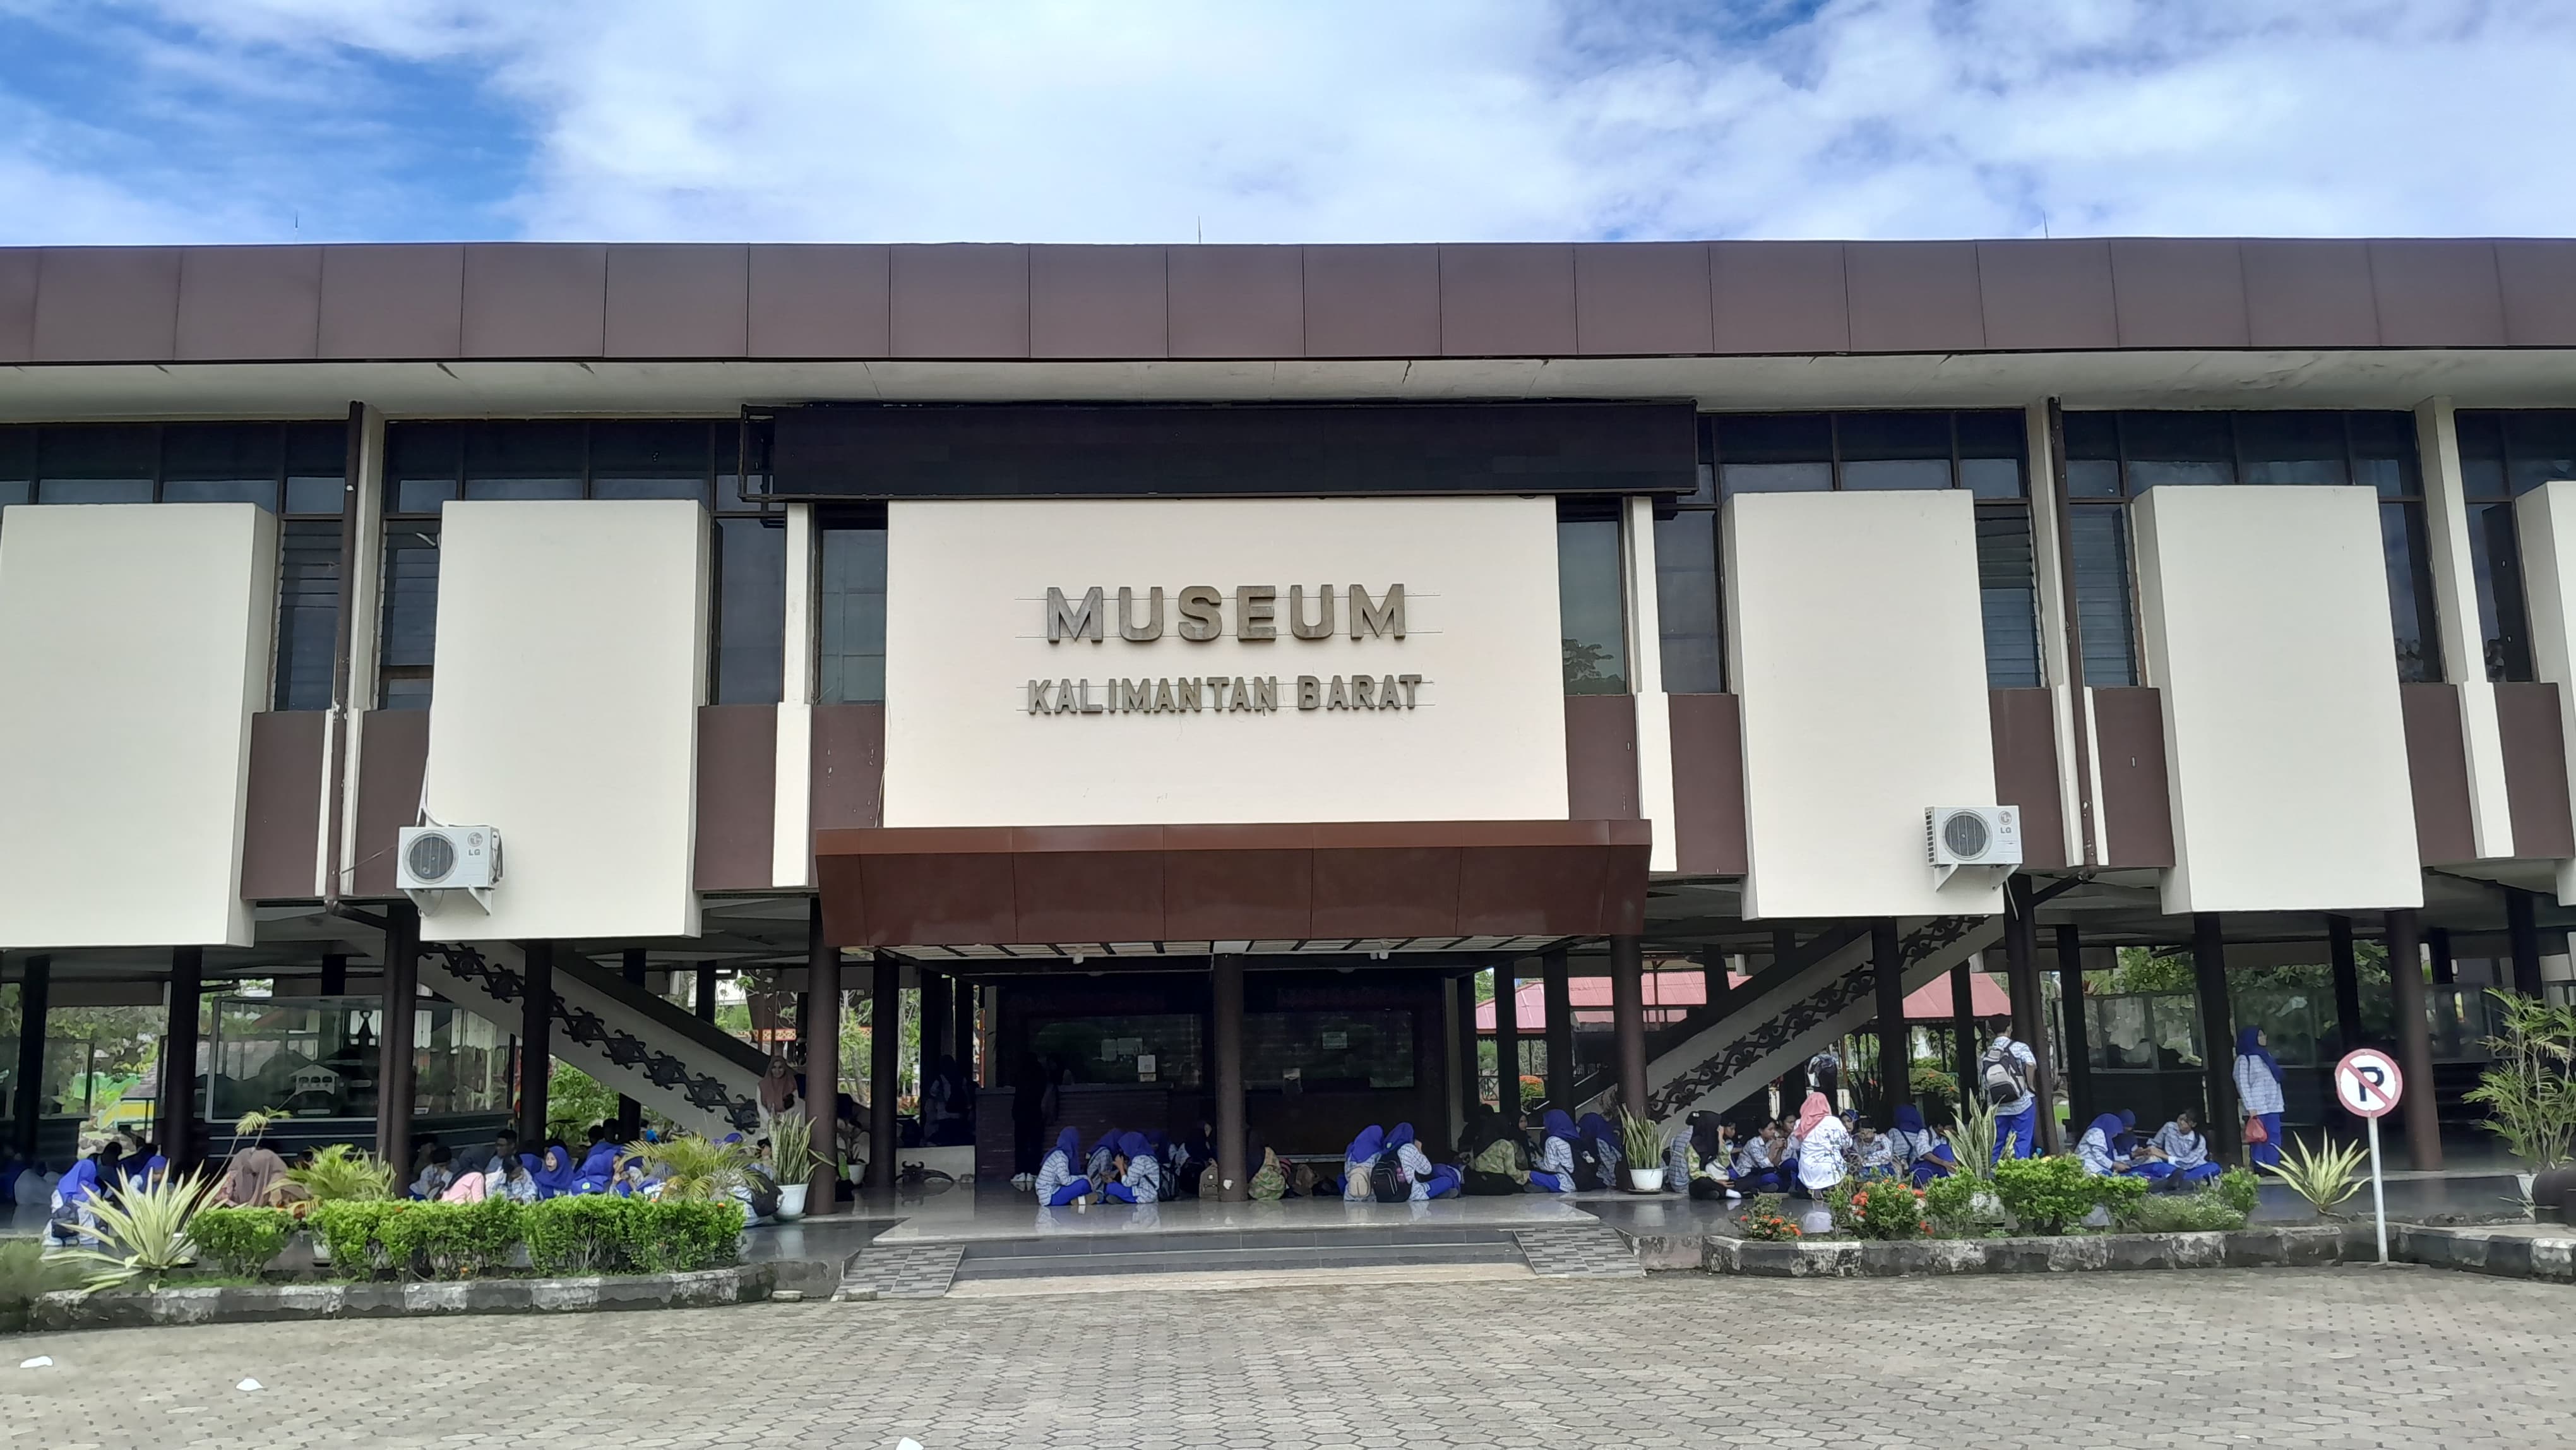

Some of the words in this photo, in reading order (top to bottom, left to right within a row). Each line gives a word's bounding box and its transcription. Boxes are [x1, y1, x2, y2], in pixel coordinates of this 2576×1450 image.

[1046, 583, 1406, 643] MUSEUM
[1027, 676, 1277, 714] KALIMANTAN
[1297, 674, 1422, 710] BARAT
[2357, 1066, 2385, 1101] P
